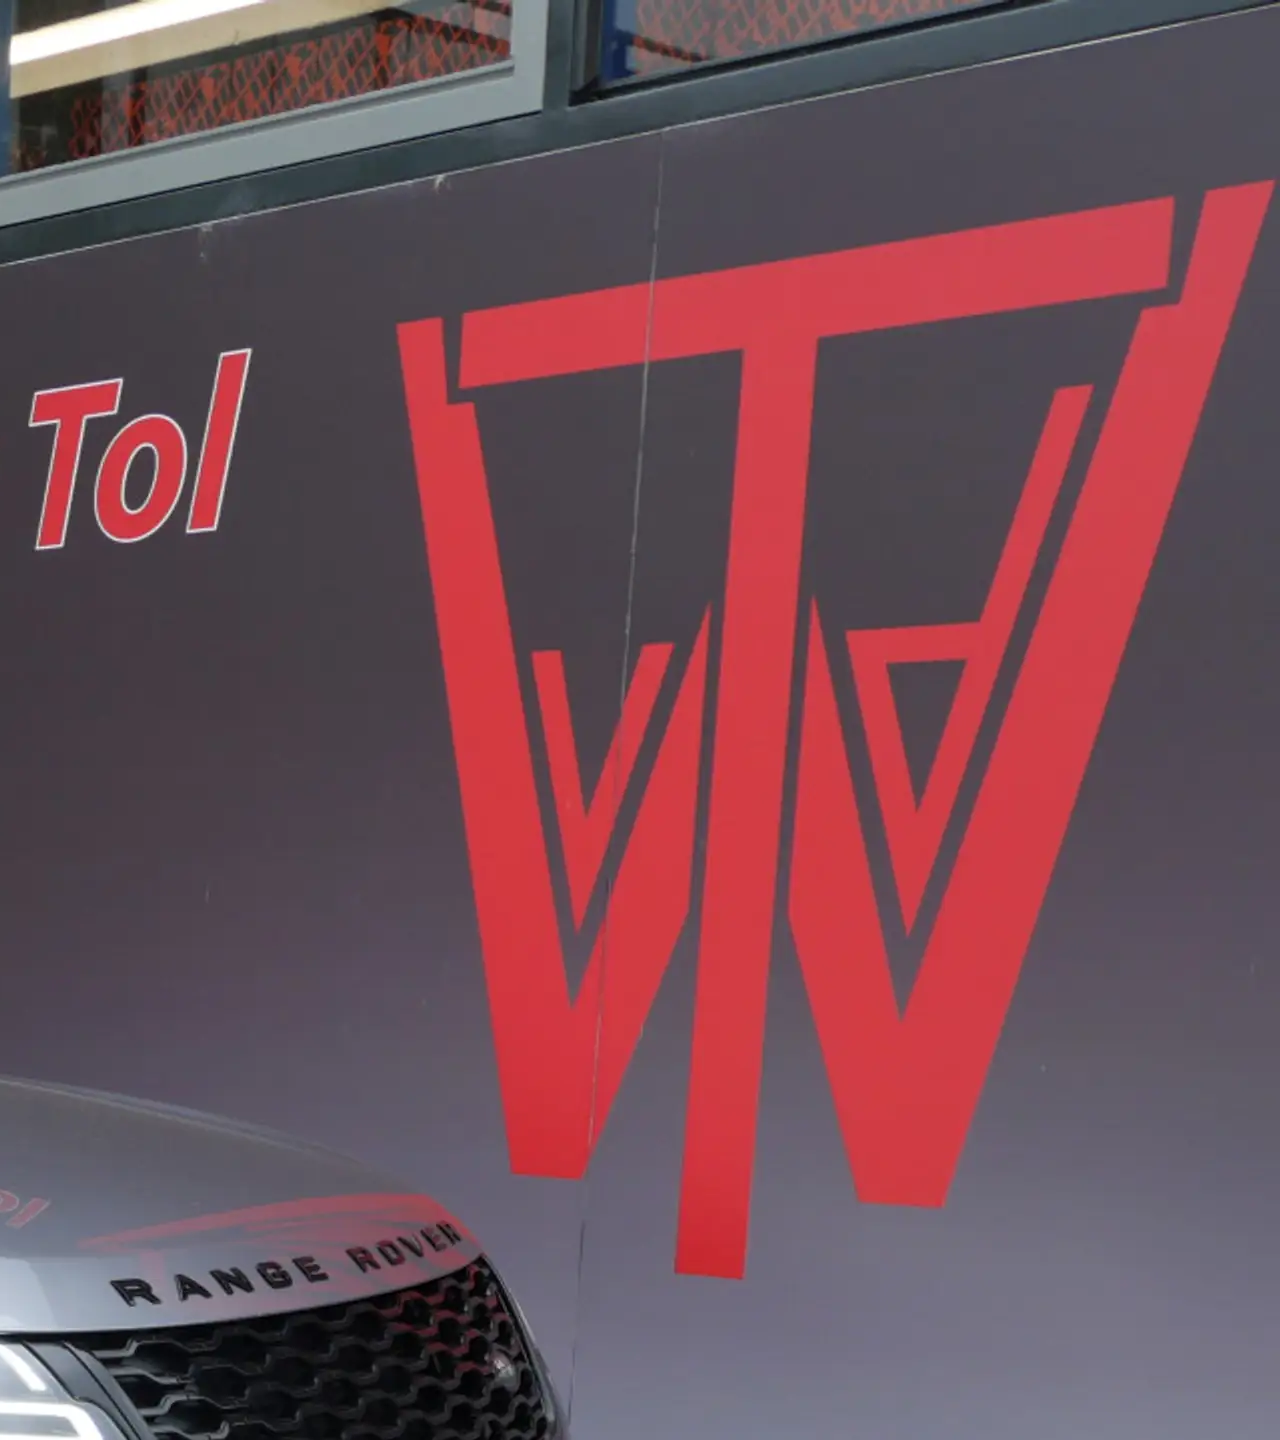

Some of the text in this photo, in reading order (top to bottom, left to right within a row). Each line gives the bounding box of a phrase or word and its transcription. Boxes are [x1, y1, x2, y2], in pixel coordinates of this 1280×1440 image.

[30, 348, 251, 550] Tol
[109, 1219, 463, 1308] RANGE ROVER
